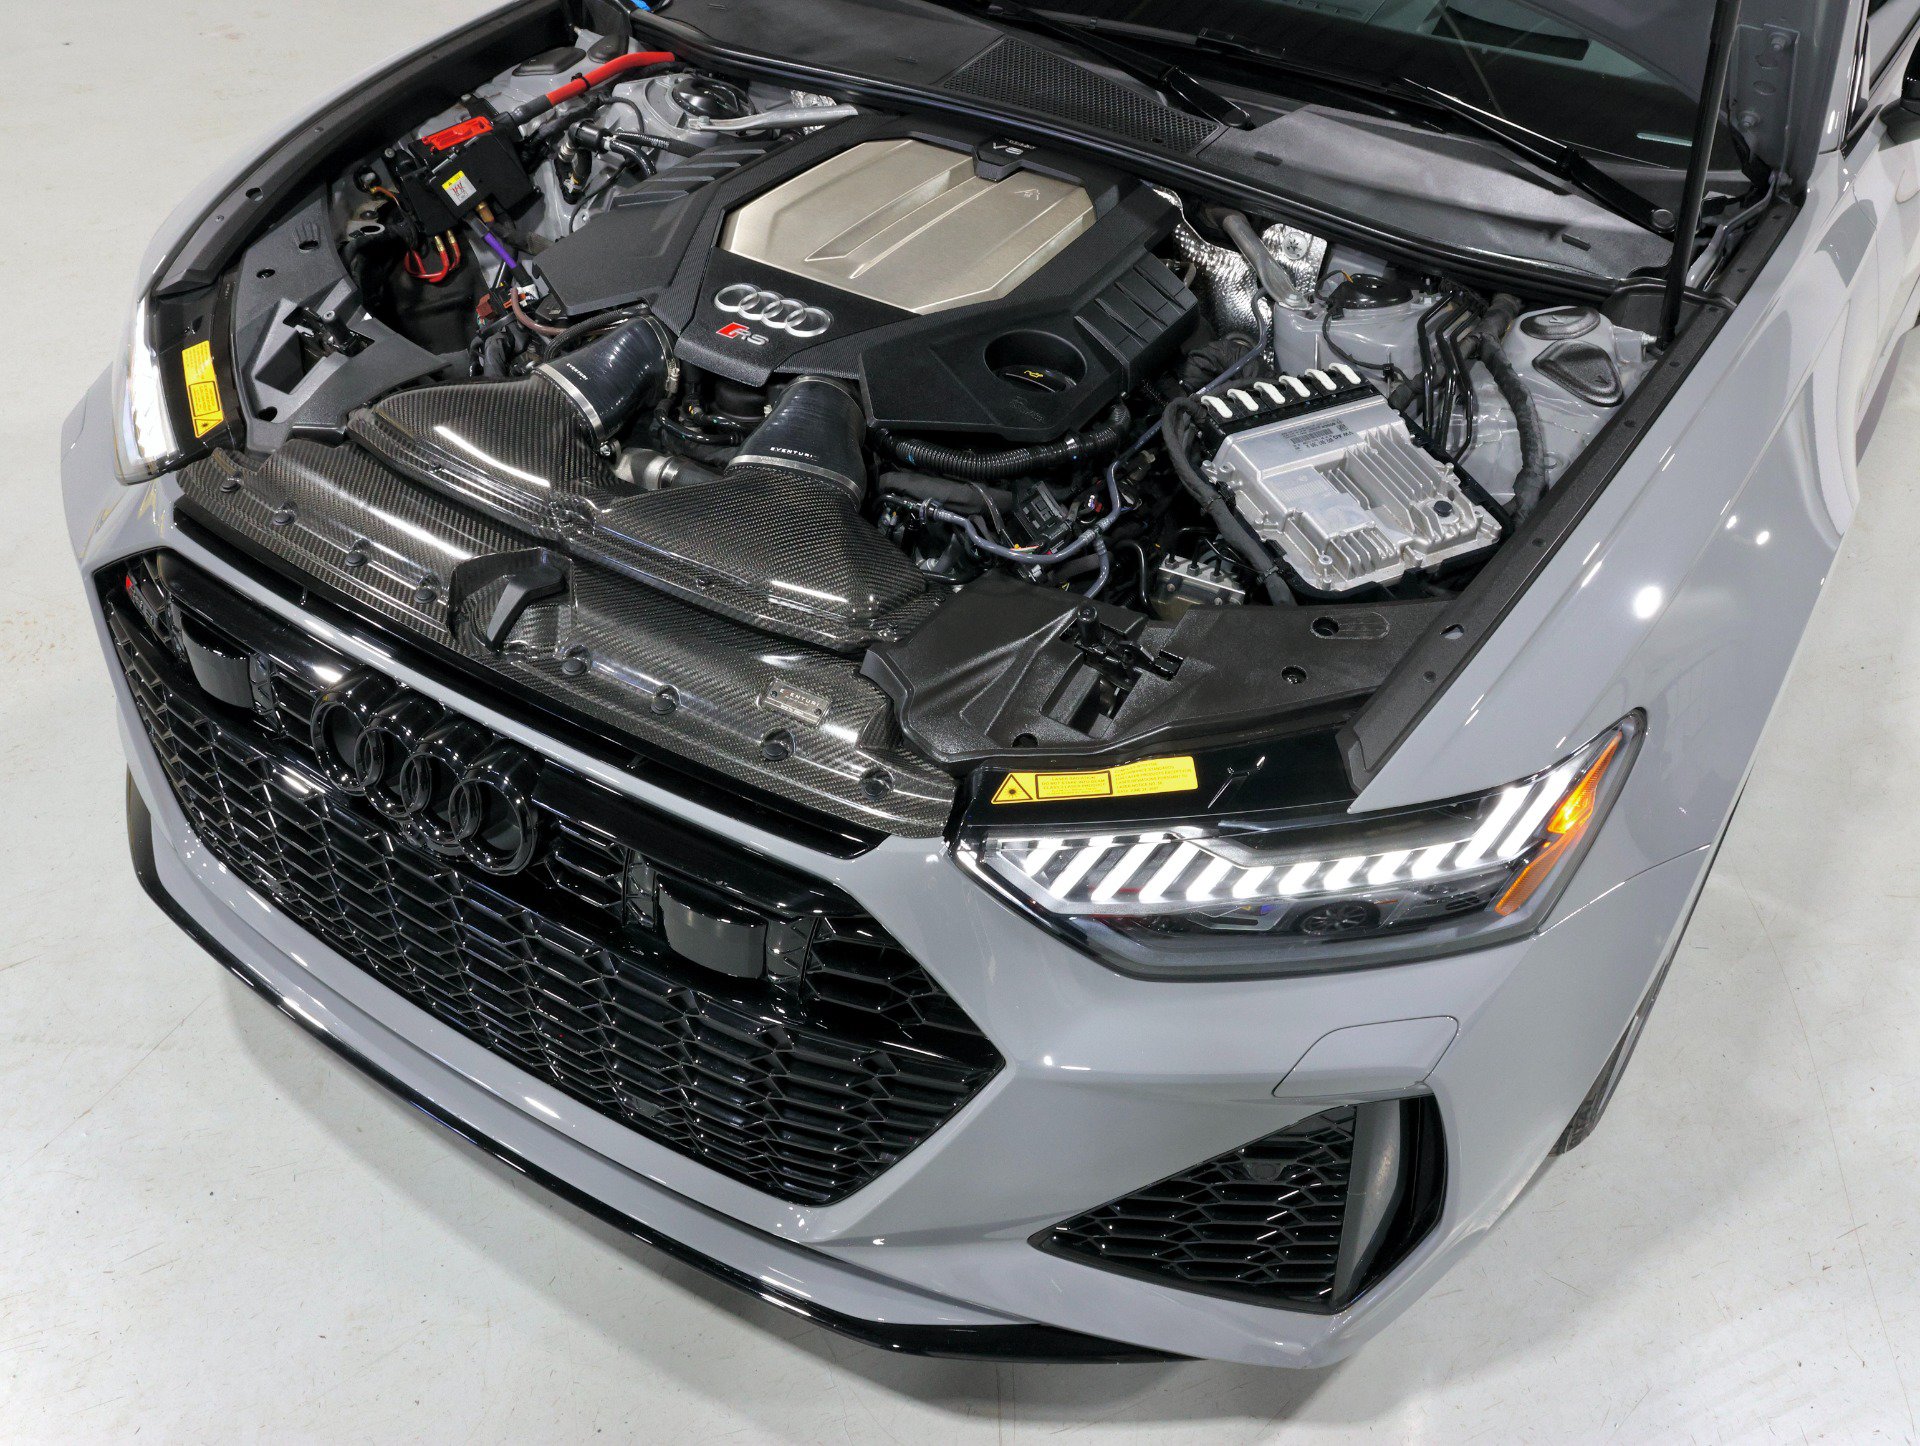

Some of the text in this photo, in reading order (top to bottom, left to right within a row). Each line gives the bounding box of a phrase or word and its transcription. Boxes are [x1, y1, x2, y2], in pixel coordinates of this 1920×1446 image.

[993, 142, 1024, 155] V8
[724, 325, 770, 346] RS
[770, 446, 813, 459] EVENTURI
